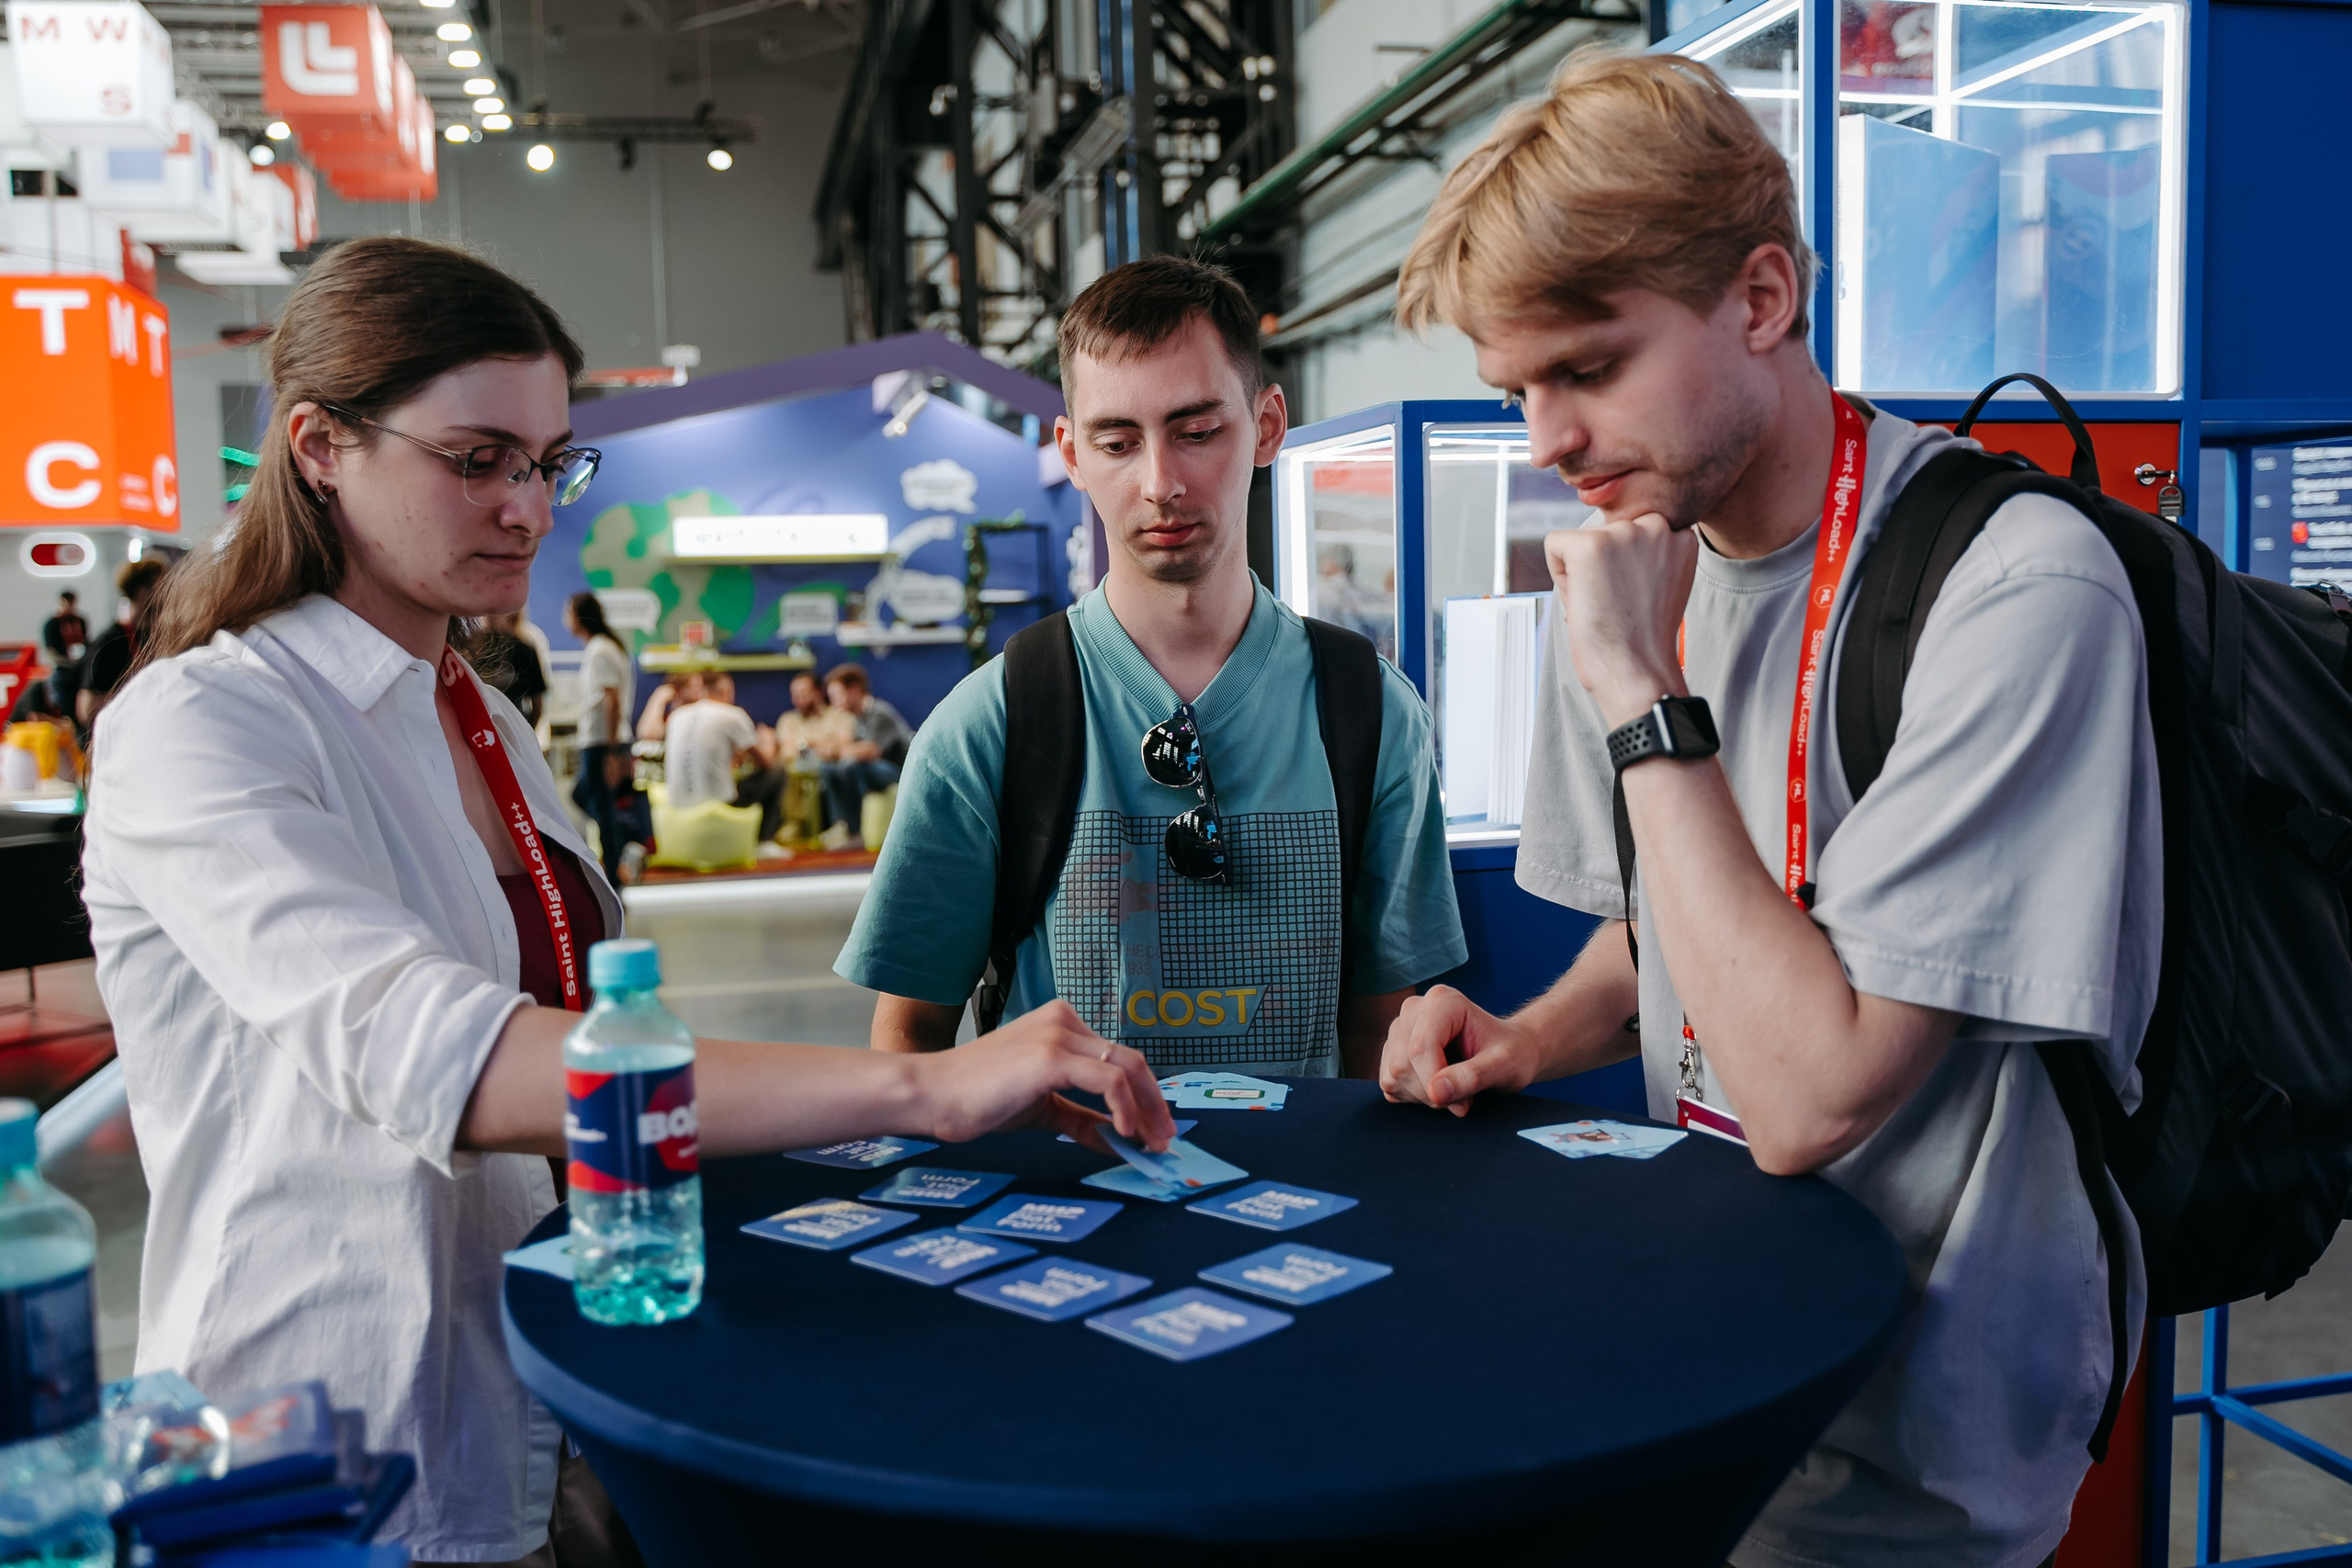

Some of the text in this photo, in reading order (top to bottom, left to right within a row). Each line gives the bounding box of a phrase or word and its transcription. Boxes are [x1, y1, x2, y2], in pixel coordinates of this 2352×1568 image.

[1842, 438, 1857, 473] Saint
[1808, 629, 1825, 666] Saint
[511, 802, 576, 997] Saint HighLoad++
[1128, 988, 1258, 1027] COST
